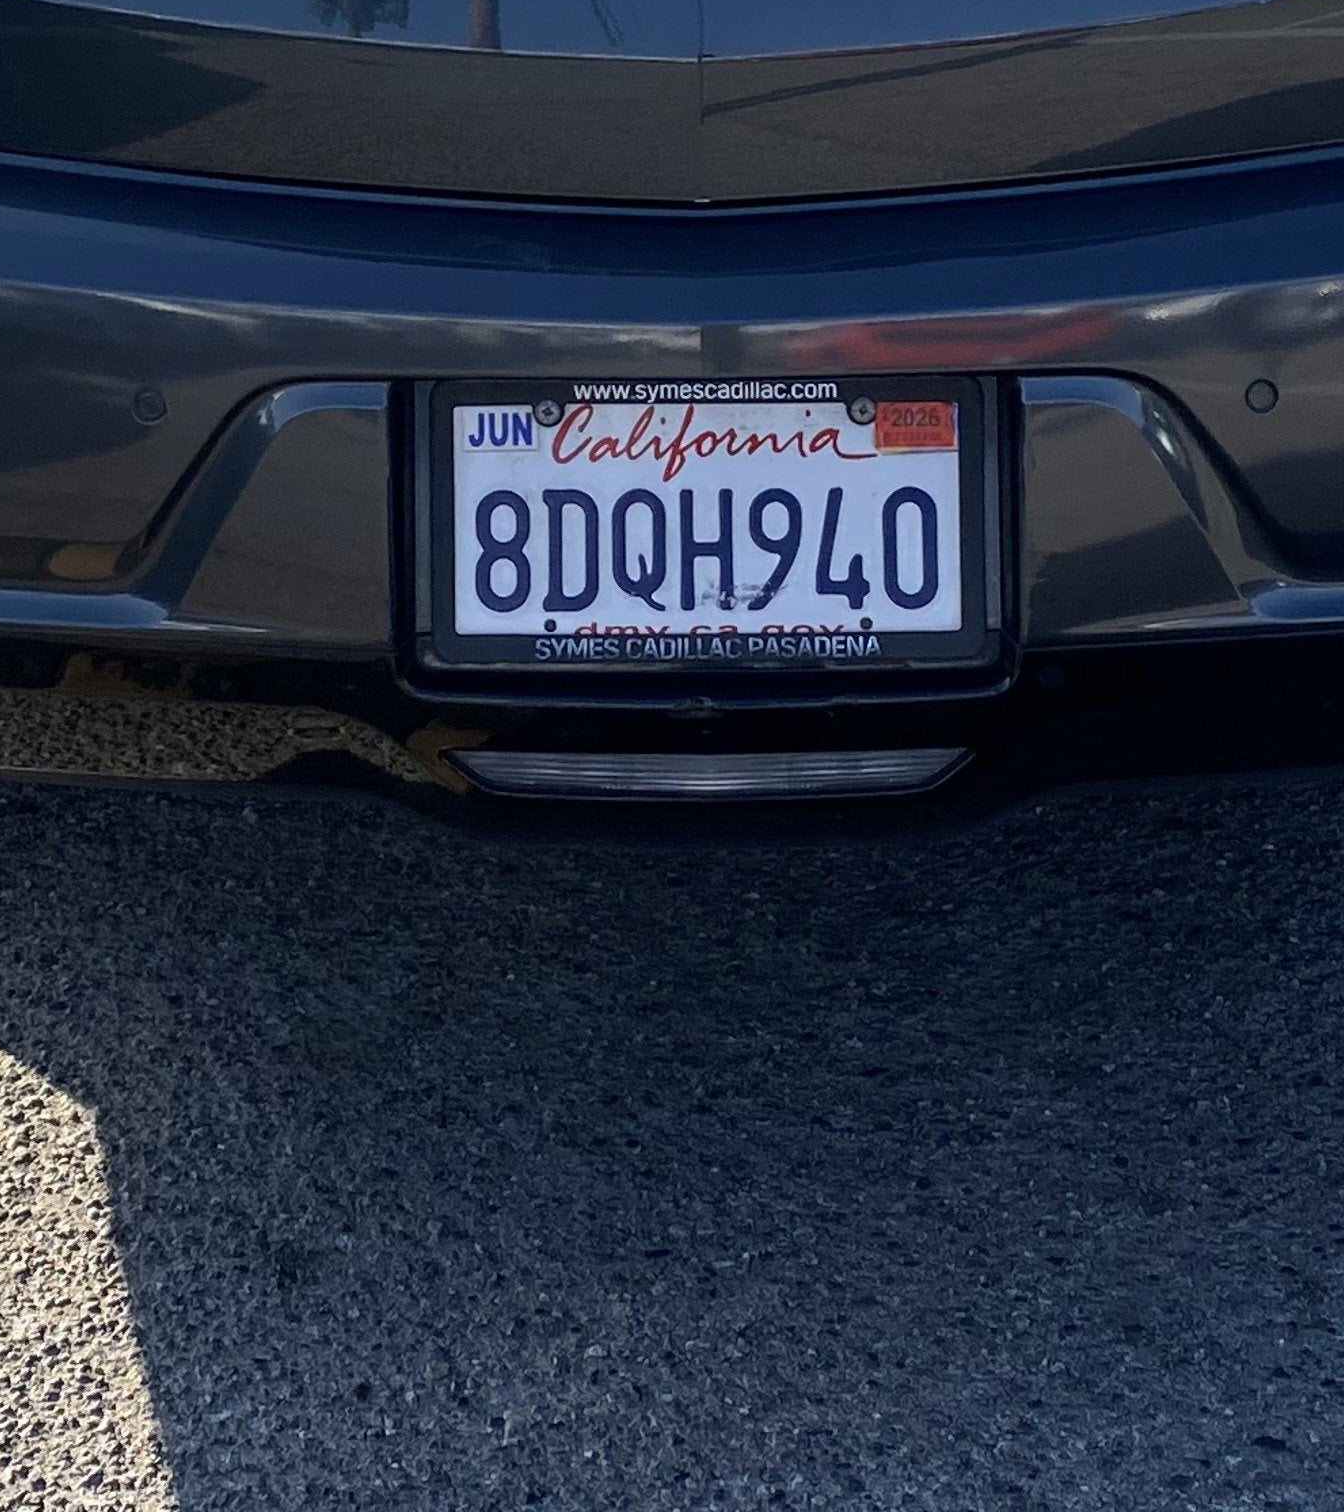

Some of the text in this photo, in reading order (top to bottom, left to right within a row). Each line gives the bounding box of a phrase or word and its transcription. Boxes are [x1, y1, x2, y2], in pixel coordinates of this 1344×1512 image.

[573, 380, 838, 403] www.symescadillac.com
[468, 412, 533, 447] JUN
[891, 407, 941, 427] 2026
[552, 401, 878, 482] California
[474, 486, 939, 613] 8DQH940
[535, 635, 883, 661] SYMES CADILLAC PASADENA
